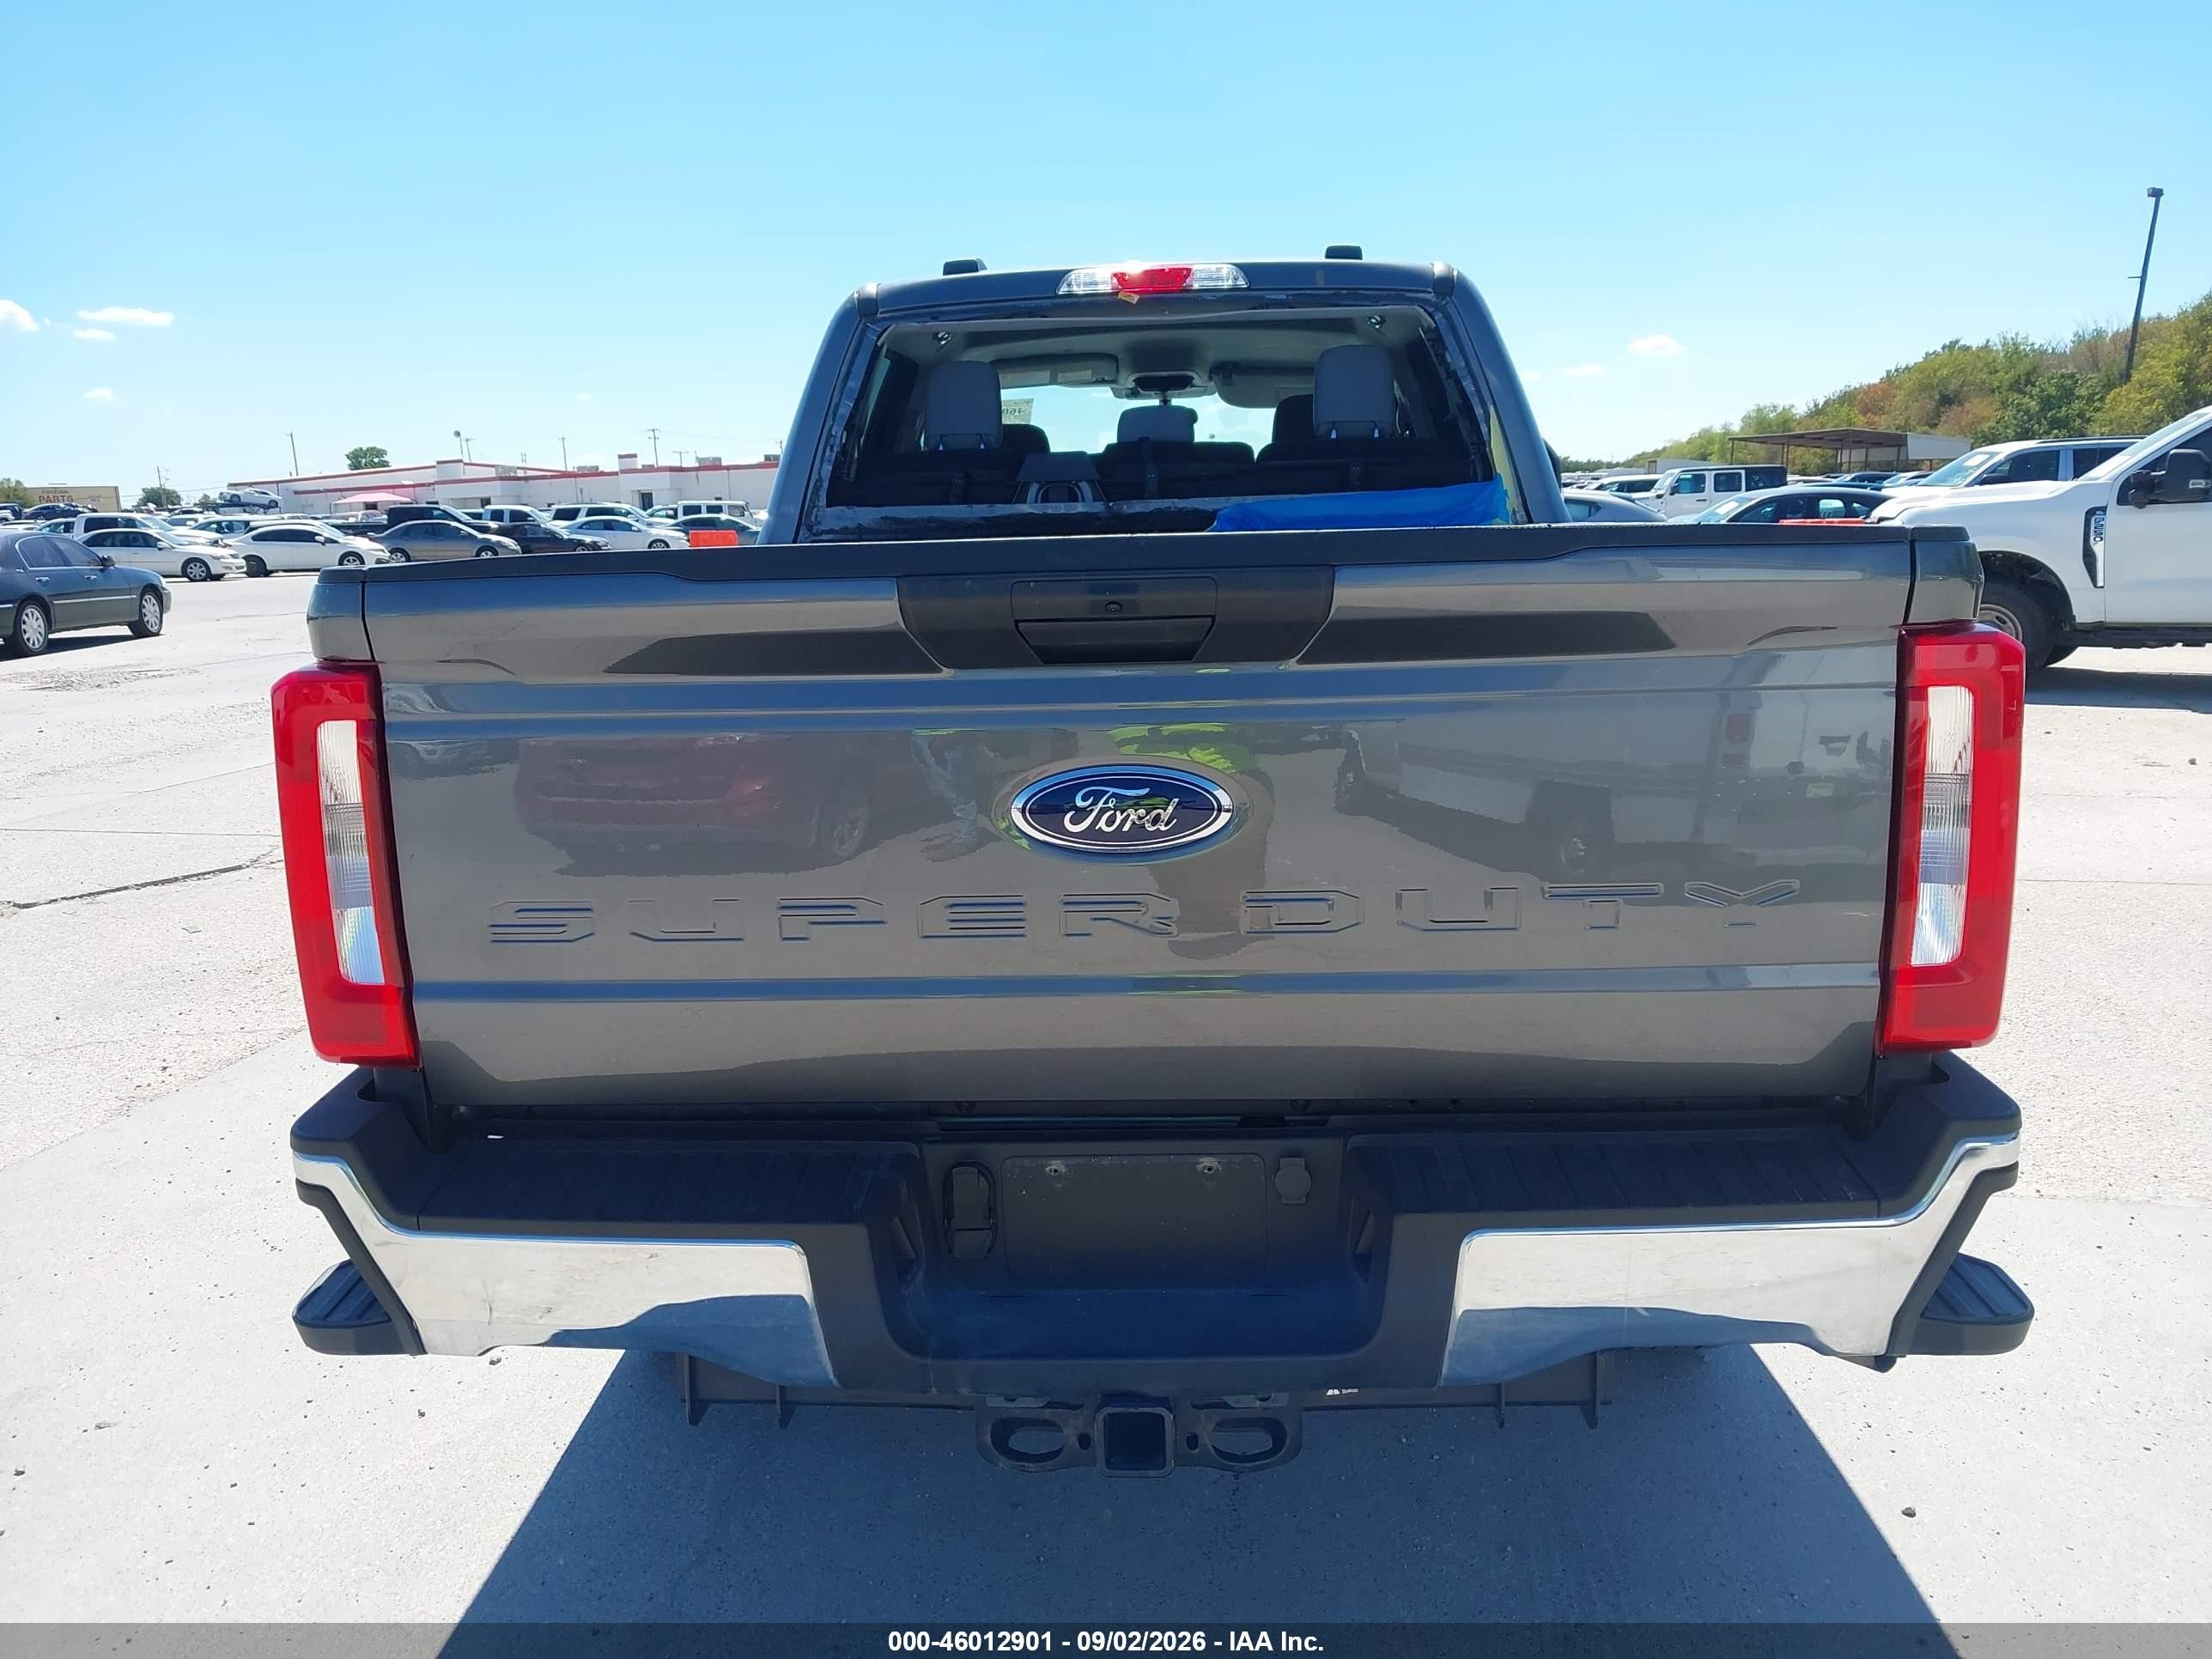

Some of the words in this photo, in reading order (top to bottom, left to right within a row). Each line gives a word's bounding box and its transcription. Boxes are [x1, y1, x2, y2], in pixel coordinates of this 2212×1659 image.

[39, 495, 74, 503] PARTS
[1063, 786, 1180, 833] Ford
[489, 893, 1179, 943] SUPER
[1239, 878, 1801, 934] DUTY
